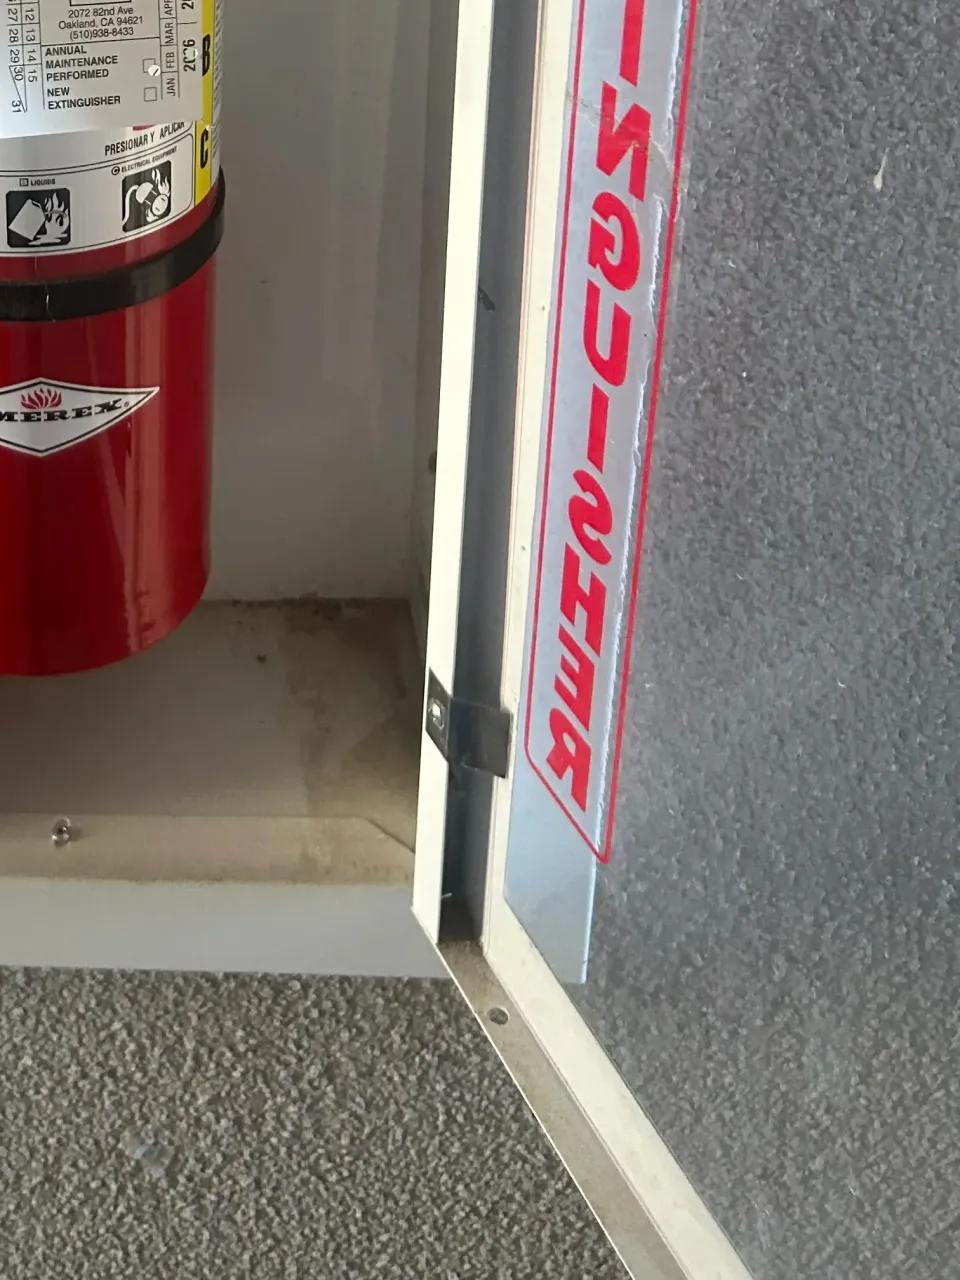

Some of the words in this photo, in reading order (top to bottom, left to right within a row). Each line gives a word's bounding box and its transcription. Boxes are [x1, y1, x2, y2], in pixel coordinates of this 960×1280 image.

[7, 8, 18, 21] 27
[24, 8, 35, 21] 12
[68, 9, 91, 19] 2072
[93, 7, 115, 17] 82nd
[117, 6, 134, 15] Ave
[58, 19, 98, 30] Oakland,
[100, 17, 115, 27] CA
[116, 16, 143, 26] 94621
[9, 28, 19, 43] 28
[26, 28, 36, 43] 13
[69, 27, 134, 42] (510)938-8433
[164, 22, 174, 45] MAR
[9, 49, 20, 64] 29
[26, 49, 37, 62] 14
[45, 45, 87, 57] ANNUAL
[202, 33, 211, 77] B
[45, 55, 119, 69] MAINTENANCE
[165, 51, 175, 69] FEB
[13, 67, 24, 82] 30
[27, 70, 38, 83] 15
[46, 68, 109, 82] PERFORMED
[47, 86, 70, 97] NEW
[11, 100, 22, 114] 31
[47, 95, 121, 110] EXTINGUISHER
[104, 136, 149, 157] PRESIONAR
[149, 131, 155, 143] Y
[200, 128, 209, 170] C
[121, 158, 151, 173] ELECTRICAL
[30, 178, 56, 186] LIQUIDS
